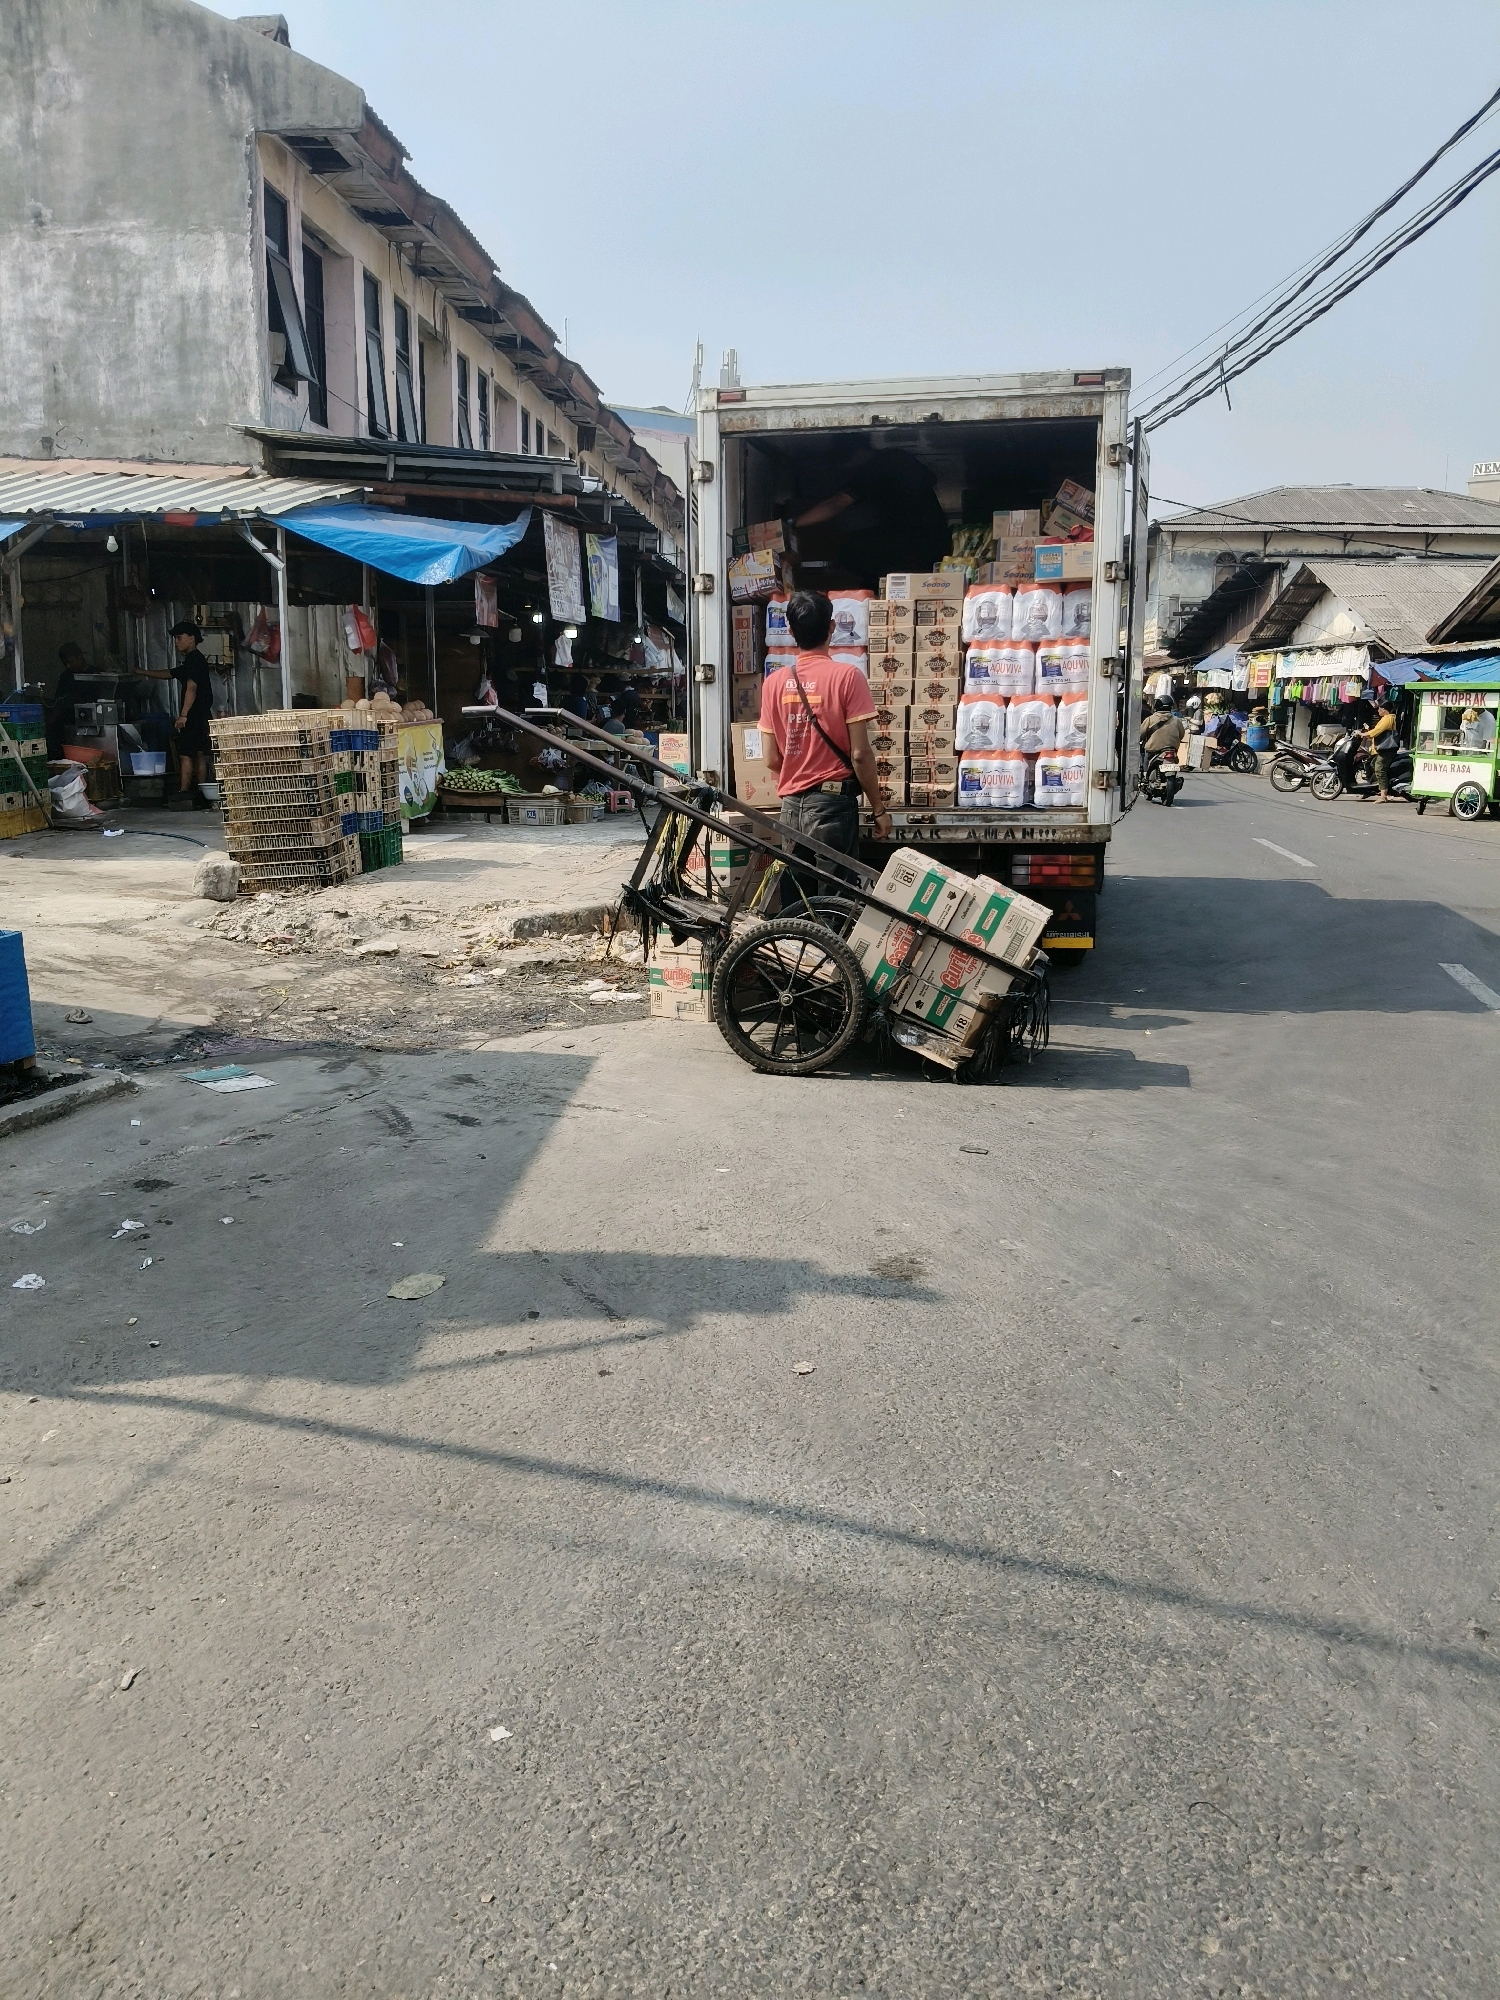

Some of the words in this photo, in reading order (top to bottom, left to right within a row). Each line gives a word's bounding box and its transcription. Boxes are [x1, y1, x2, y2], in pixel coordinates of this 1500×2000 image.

[1003, 571, 1035, 579] Sedaap
[990, 662, 1022, 674] AQUVIVA
[1062, 659, 1089, 671] AQUVIV
[1430, 691, 1487, 706] KETOPRAK
[1423, 762, 1448, 773] PUNYA
[1450, 764, 1471, 774] RASA
[982, 774, 1014, 785] AQUVIVA
[1062, 770, 1084, 781] AQUV
[862, 828, 942, 840] JRAK
[902, 870, 916, 885] 18
[941, 933, 982, 989] GuriBe
[965, 956, 980, 975] Layer
[663, 968, 692, 983] GuriBee
[955, 1017, 968, 1031] 18
